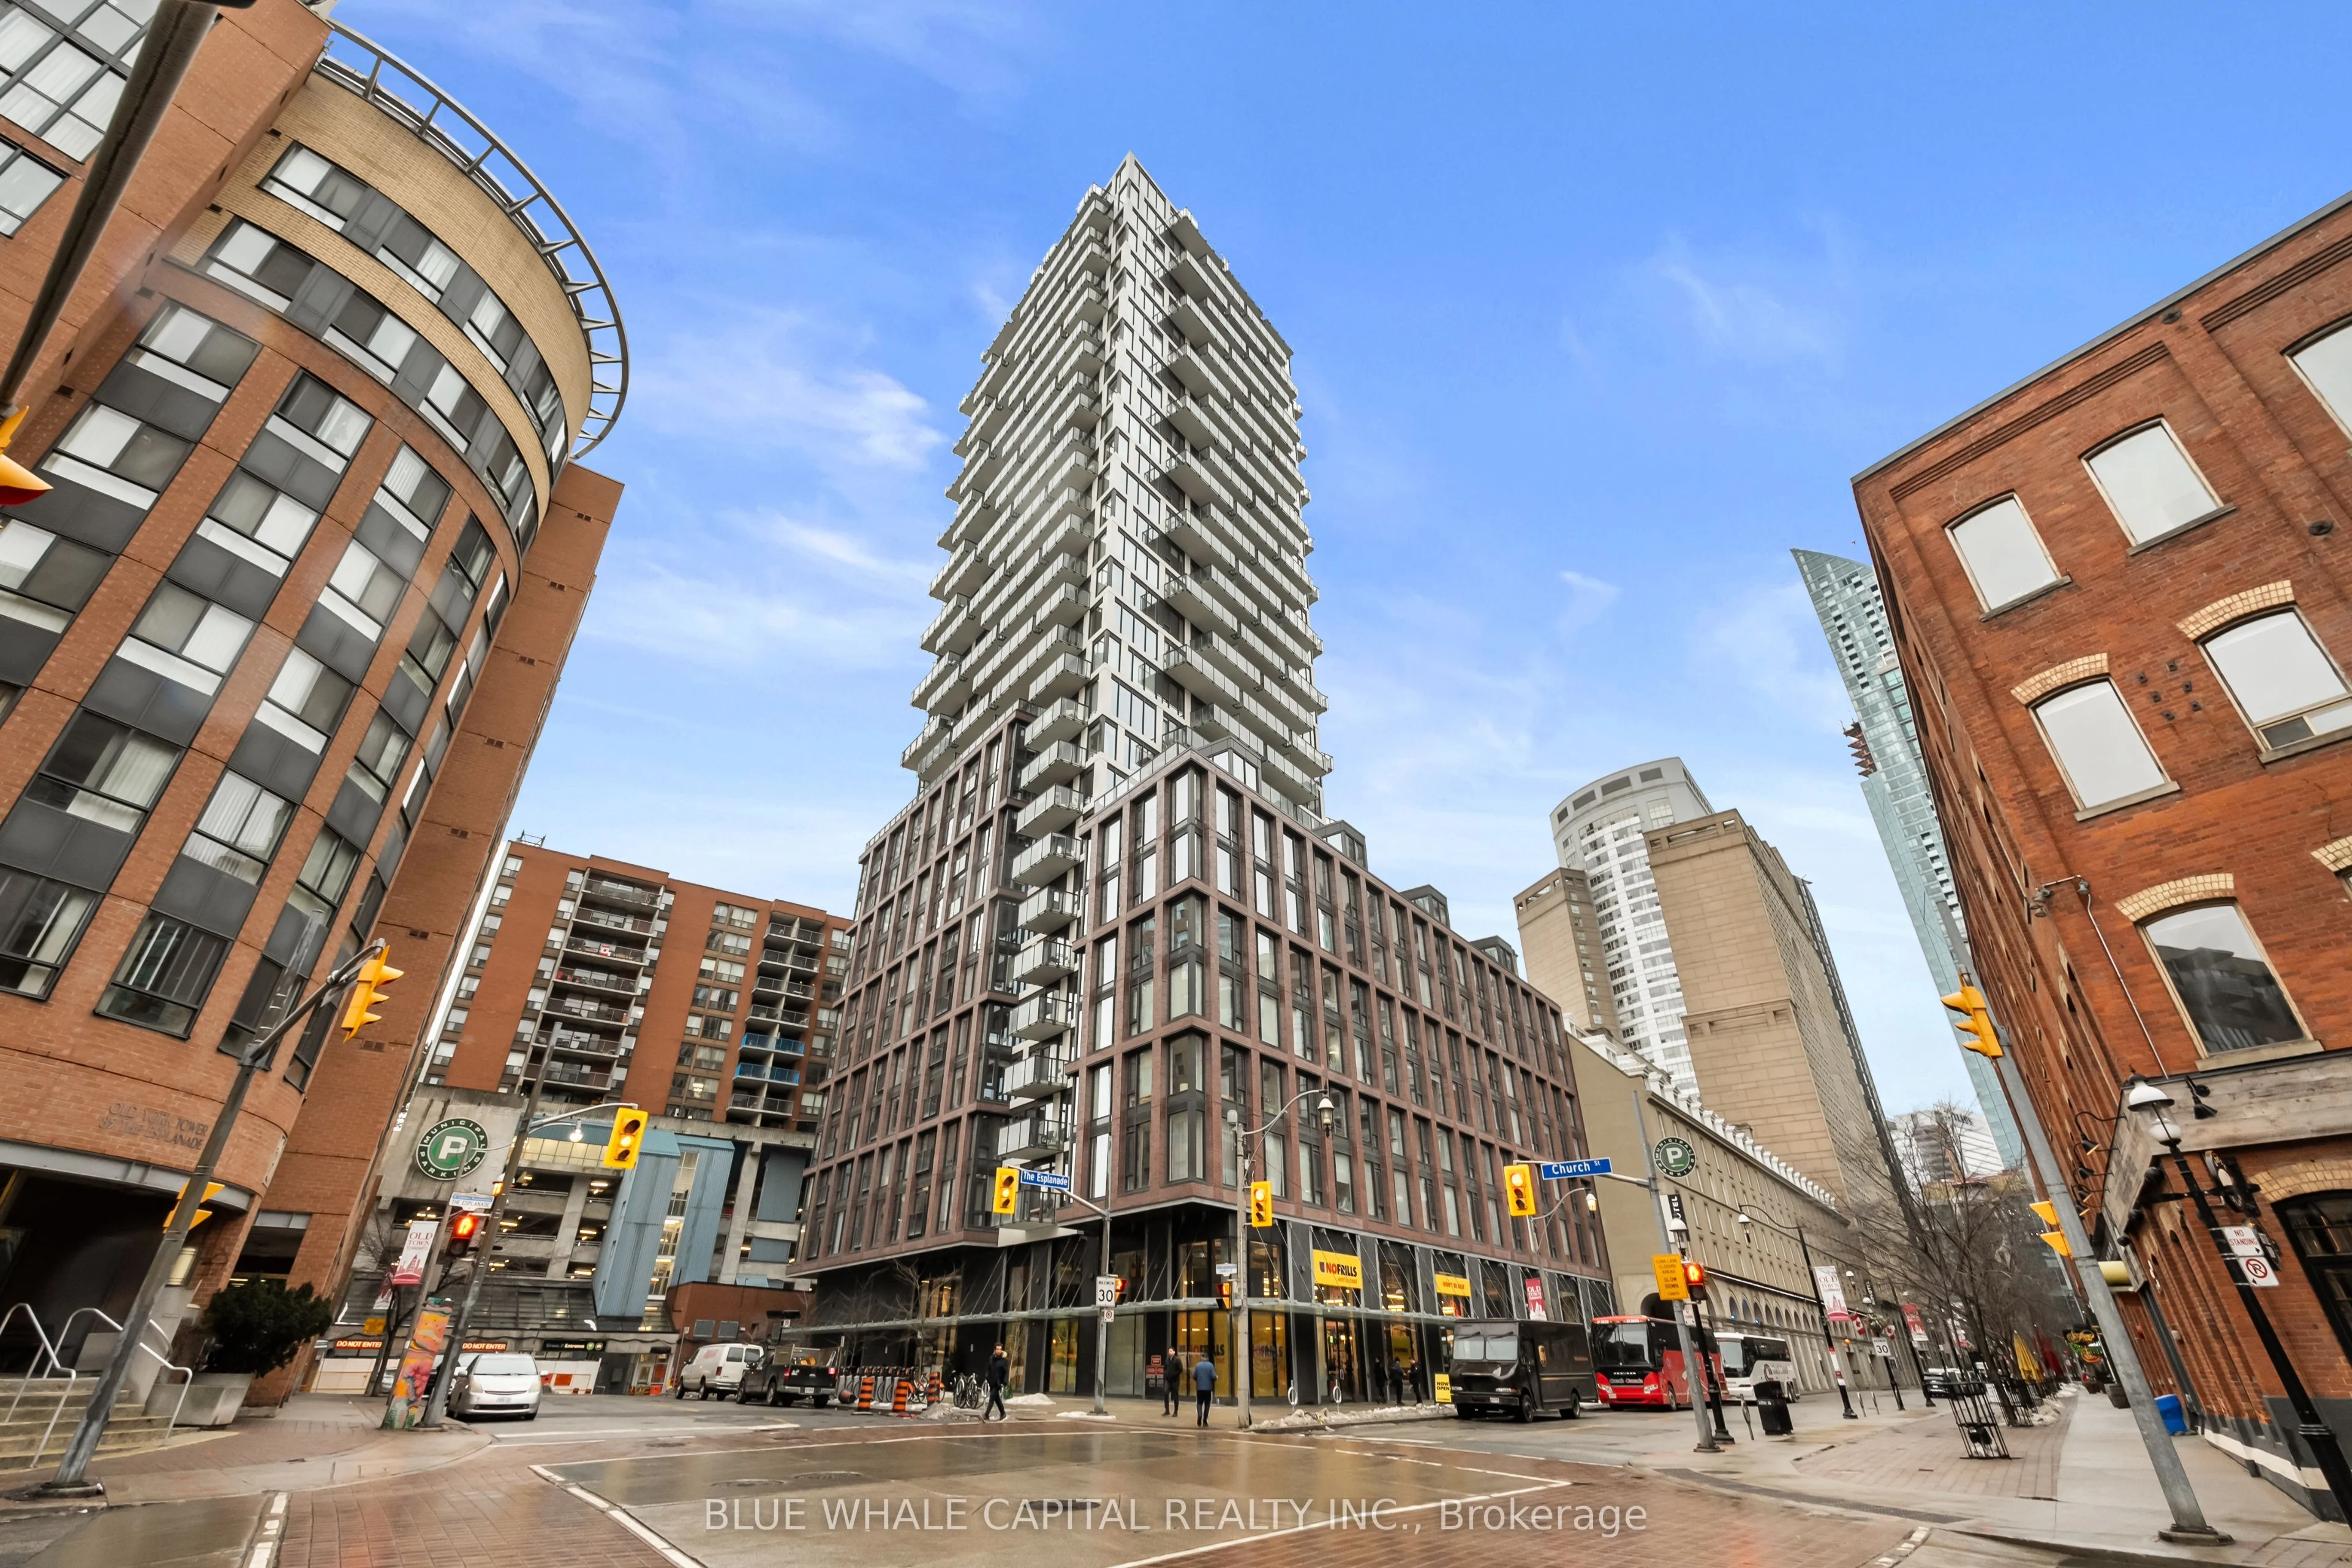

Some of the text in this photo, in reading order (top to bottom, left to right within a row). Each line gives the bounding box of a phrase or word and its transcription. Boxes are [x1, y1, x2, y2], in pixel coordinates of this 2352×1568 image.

[110, 1103, 137, 1118] OLD
[176, 1118, 209, 1136] TOWER
[143, 1127, 205, 1150] ESPLANADE
[423, 1121, 486, 1148] MUNICIPAL
[1656, 1139, 1692, 1158] MUNICIPAL
[1666, 1147, 1683, 1164] P
[420, 1152, 481, 1177] PARKING
[1552, 1161, 1591, 1175] Church
[1658, 1158, 1694, 1176] PARKING
[1023, 1171, 1068, 1186] The Esplanade
[1098, 1289, 1113, 1302] 30
